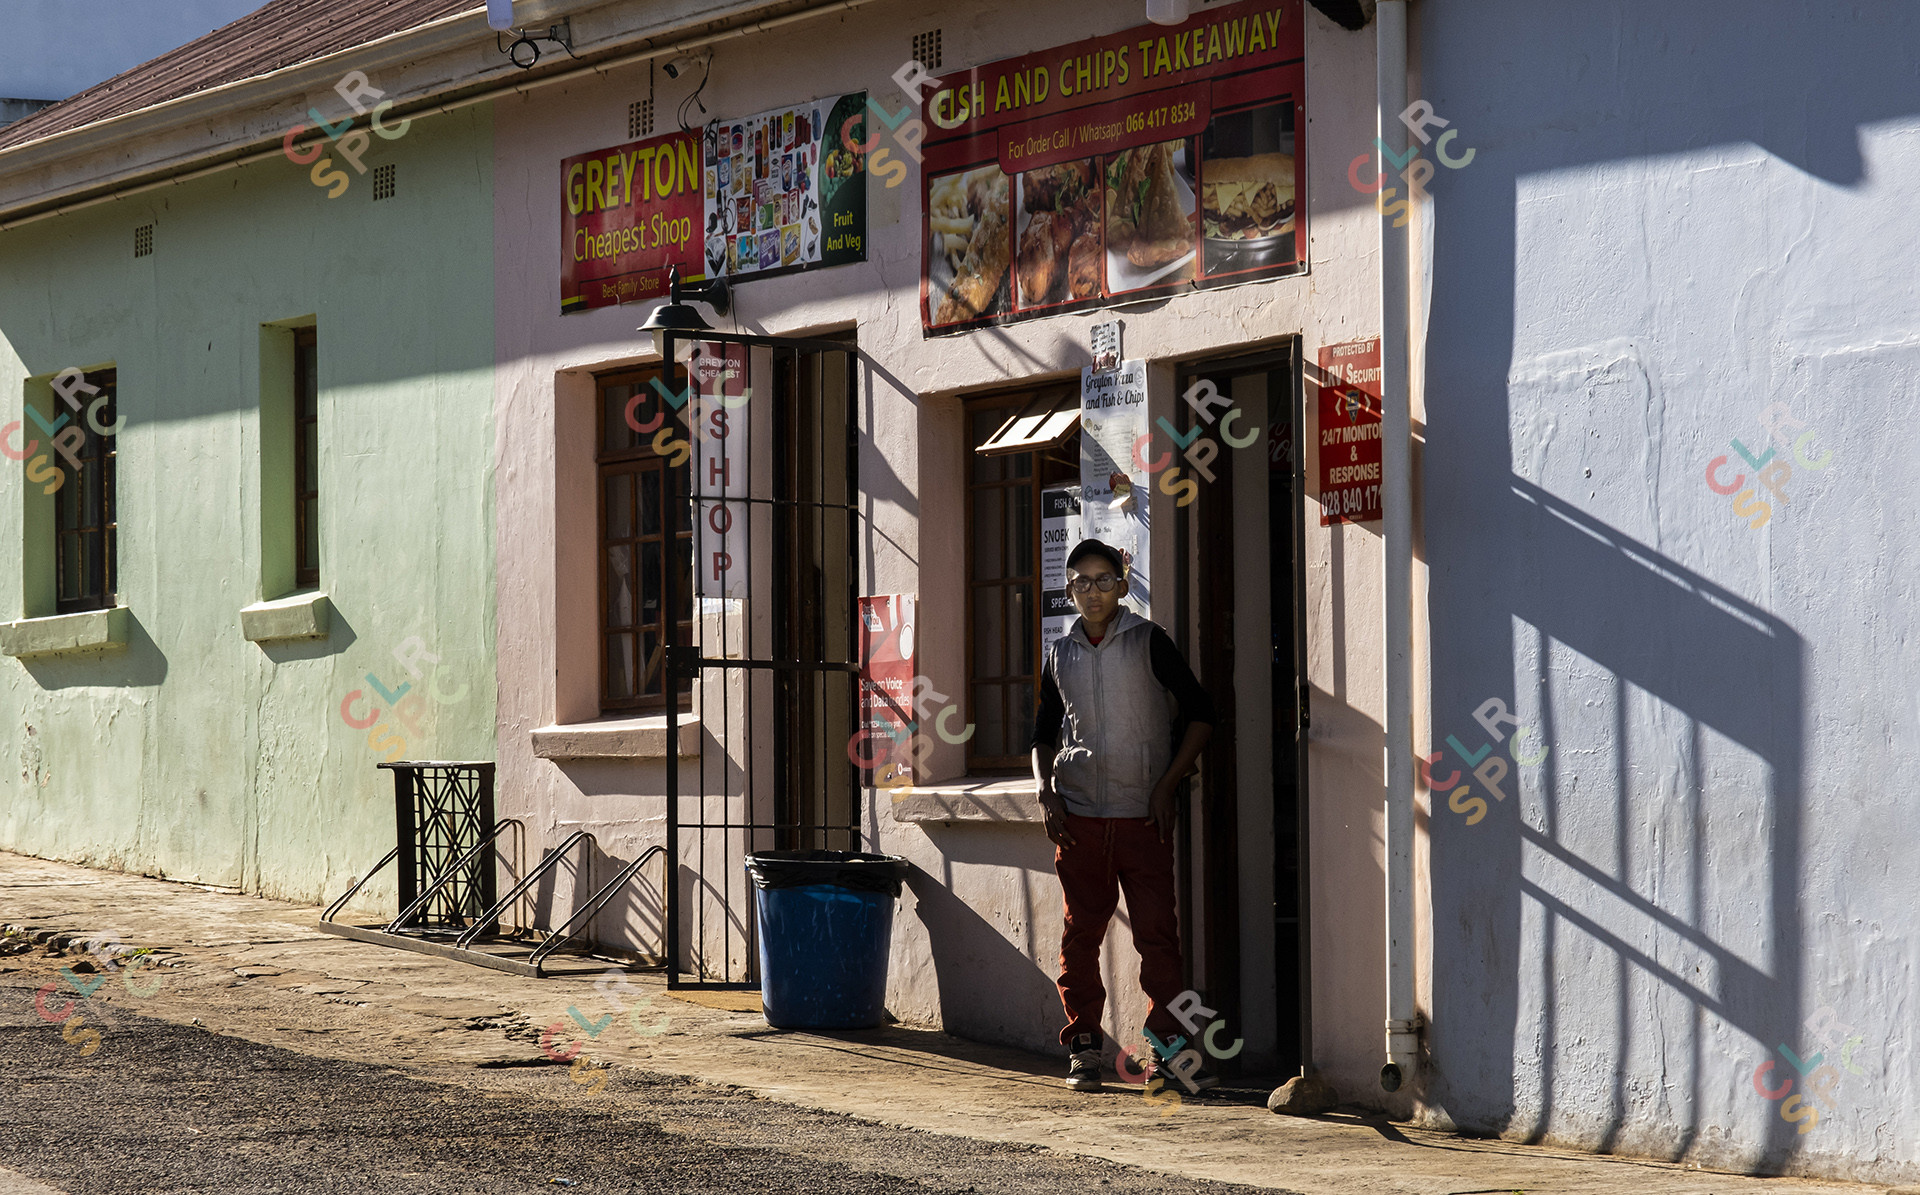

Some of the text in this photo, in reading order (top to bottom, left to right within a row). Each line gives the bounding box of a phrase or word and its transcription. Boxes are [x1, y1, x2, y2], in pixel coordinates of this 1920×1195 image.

[937, 8, 1282, 126] FISH AND CHIPS TAKEAWAY
[1008, 101, 1196, 159] For Order Call / Whatsapp: 066 417 8534
[566, 138, 699, 216] GREYTON
[833, 210, 853, 227] Fruit
[573, 220, 646, 266] Cheapest
[651, 211, 691, 252] Shop
[826, 233, 861, 251] And Veg
[602, 276, 660, 298] Best Family Store
[1332, 341, 1375, 357] PROTECTED BY
[699, 357, 741, 368] GREYON
[699, 369, 741, 379] CHEAEST
[1085, 371, 1134, 393] Greyton Pizza
[1085, 389, 1144, 409] and Fish & Chips
[1322, 428, 1341, 446] 24/7
[1350, 445, 1358, 461] &
[1330, 463, 1380, 484] RESPONSE
[1054, 498, 1067, 509] FISH
[1321, 490, 1340, 517] 028
[1342, 486, 1363, 514] 840
[1044, 528, 1070, 543] SNOEK
[861, 679, 877, 691] Save
[886, 676, 903, 690] Voice
[873, 694, 889, 707] Data
